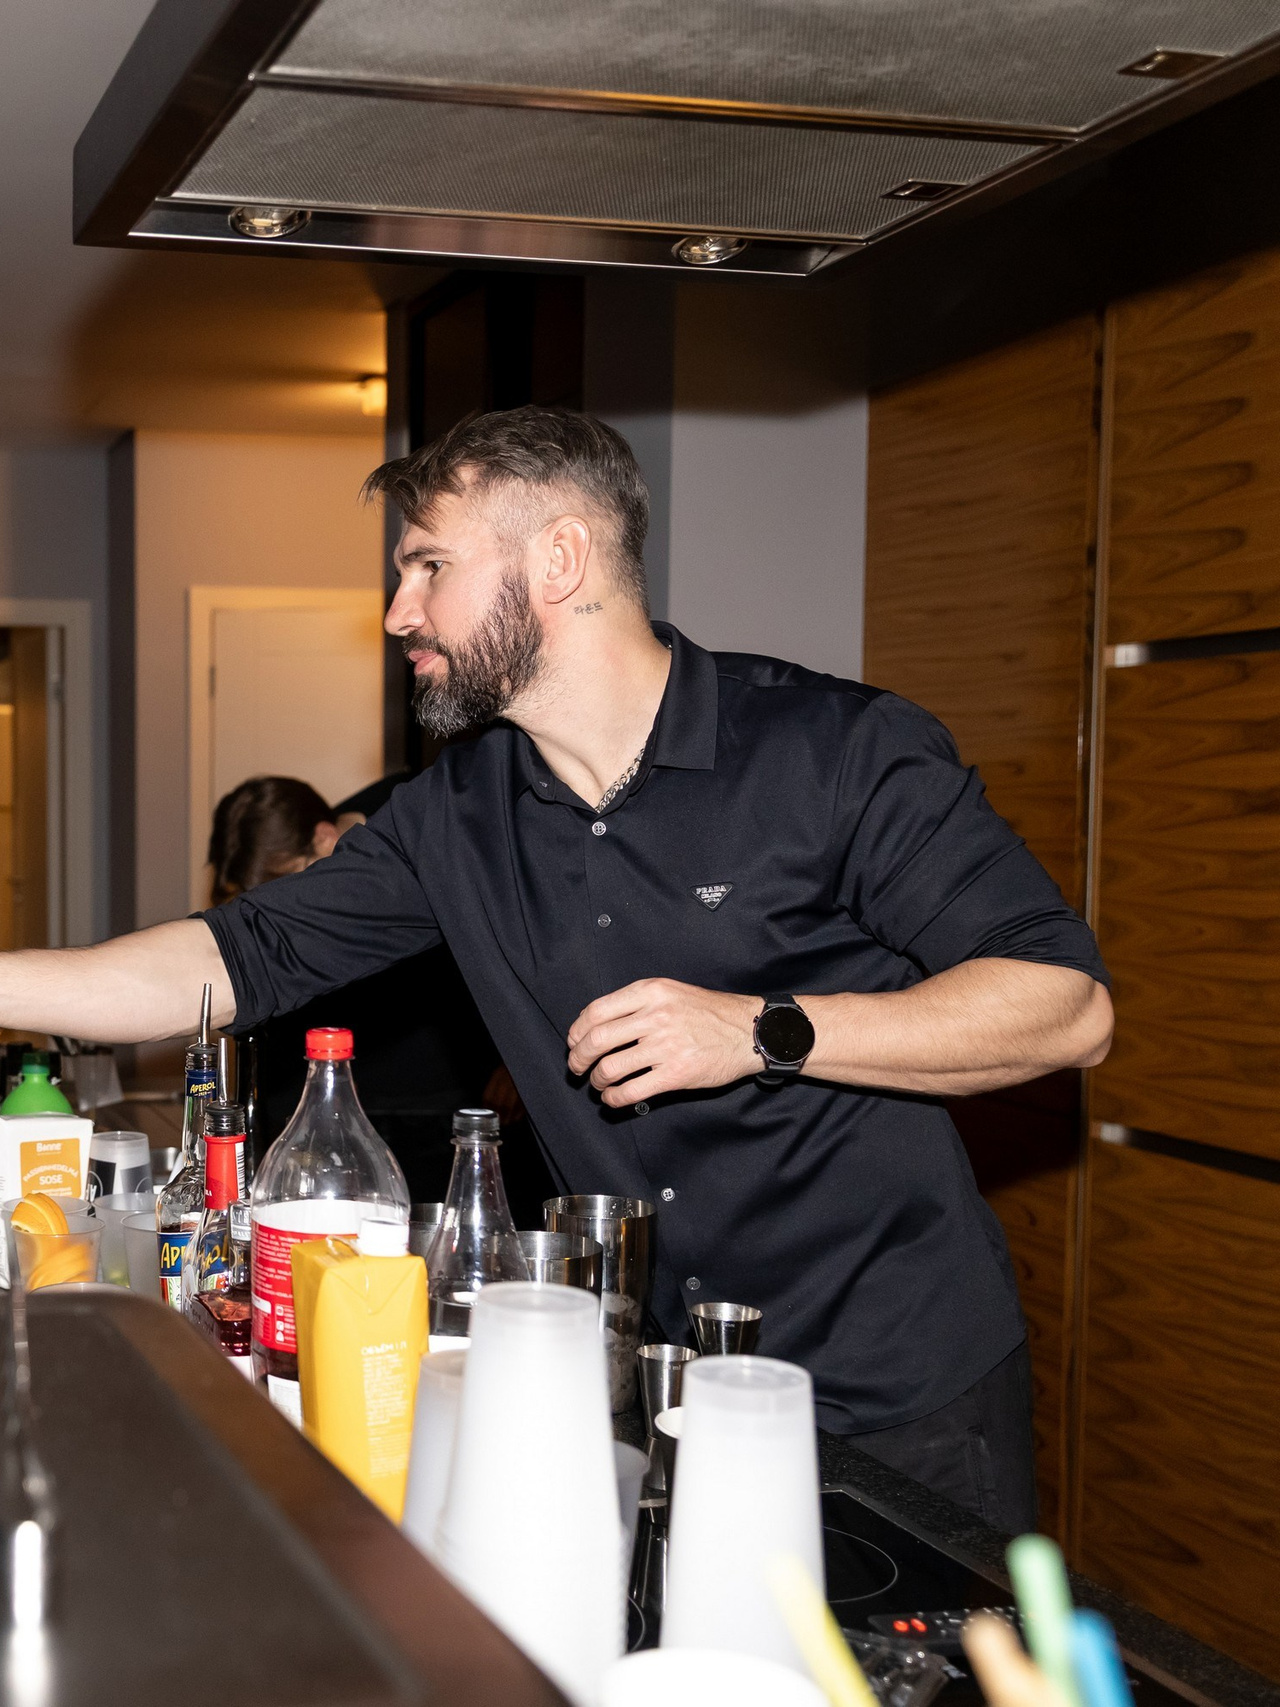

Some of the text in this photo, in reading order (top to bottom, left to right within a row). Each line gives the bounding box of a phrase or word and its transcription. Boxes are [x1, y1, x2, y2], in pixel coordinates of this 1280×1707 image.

[696, 885, 726, 894] PRADA
[190, 1082, 216, 1093] APEROL
[36, 1143, 62, 1152] Bonne
[39, 1174, 63, 1186] SOSE
